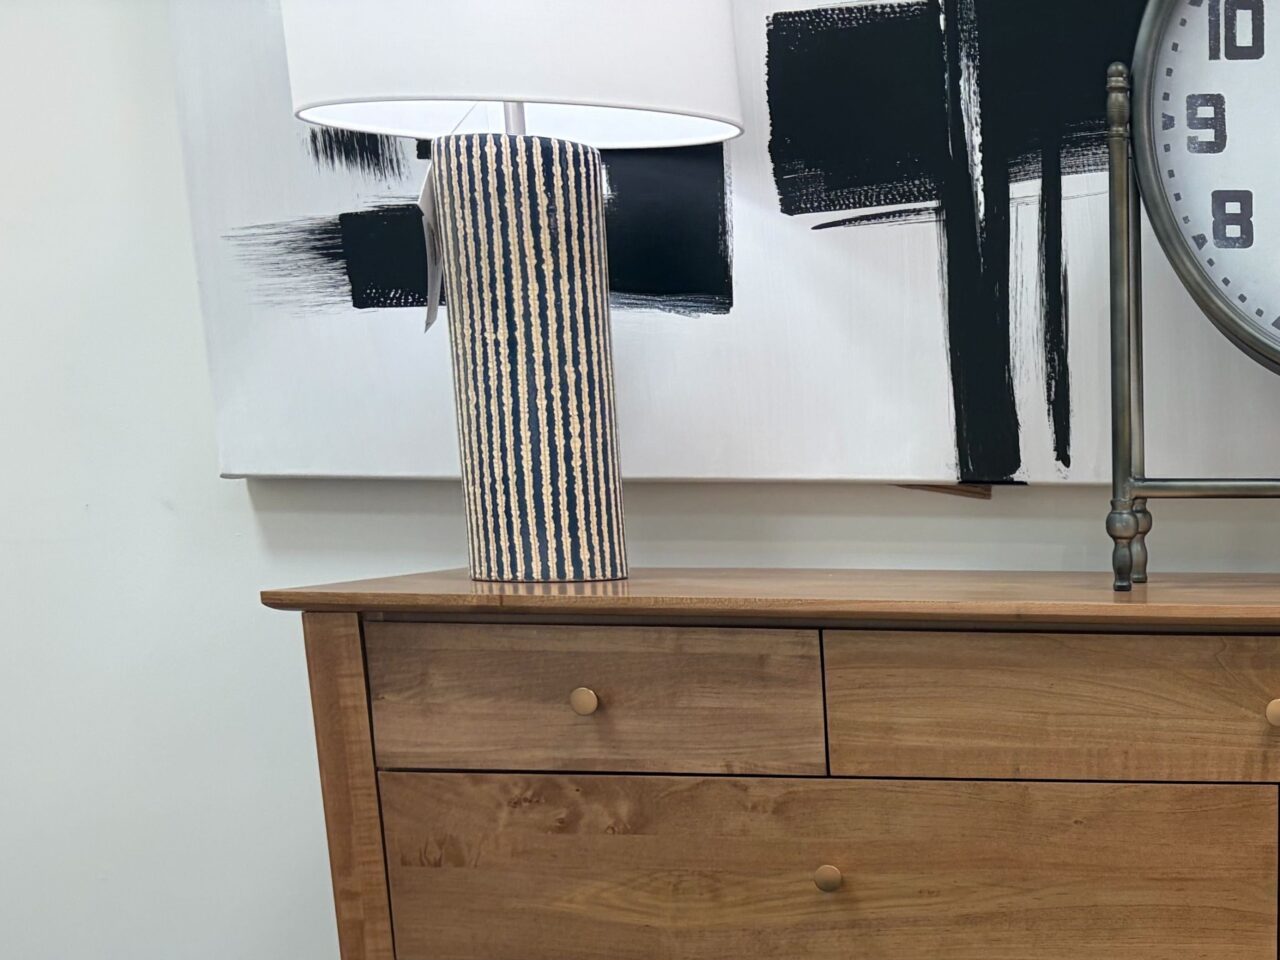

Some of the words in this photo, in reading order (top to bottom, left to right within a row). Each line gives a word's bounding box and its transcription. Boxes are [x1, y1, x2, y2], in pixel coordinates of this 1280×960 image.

[1208, 0, 1264, 60] 10
[1186, 93, 1227, 153] 9
[1211, 190, 1254, 248] 8
